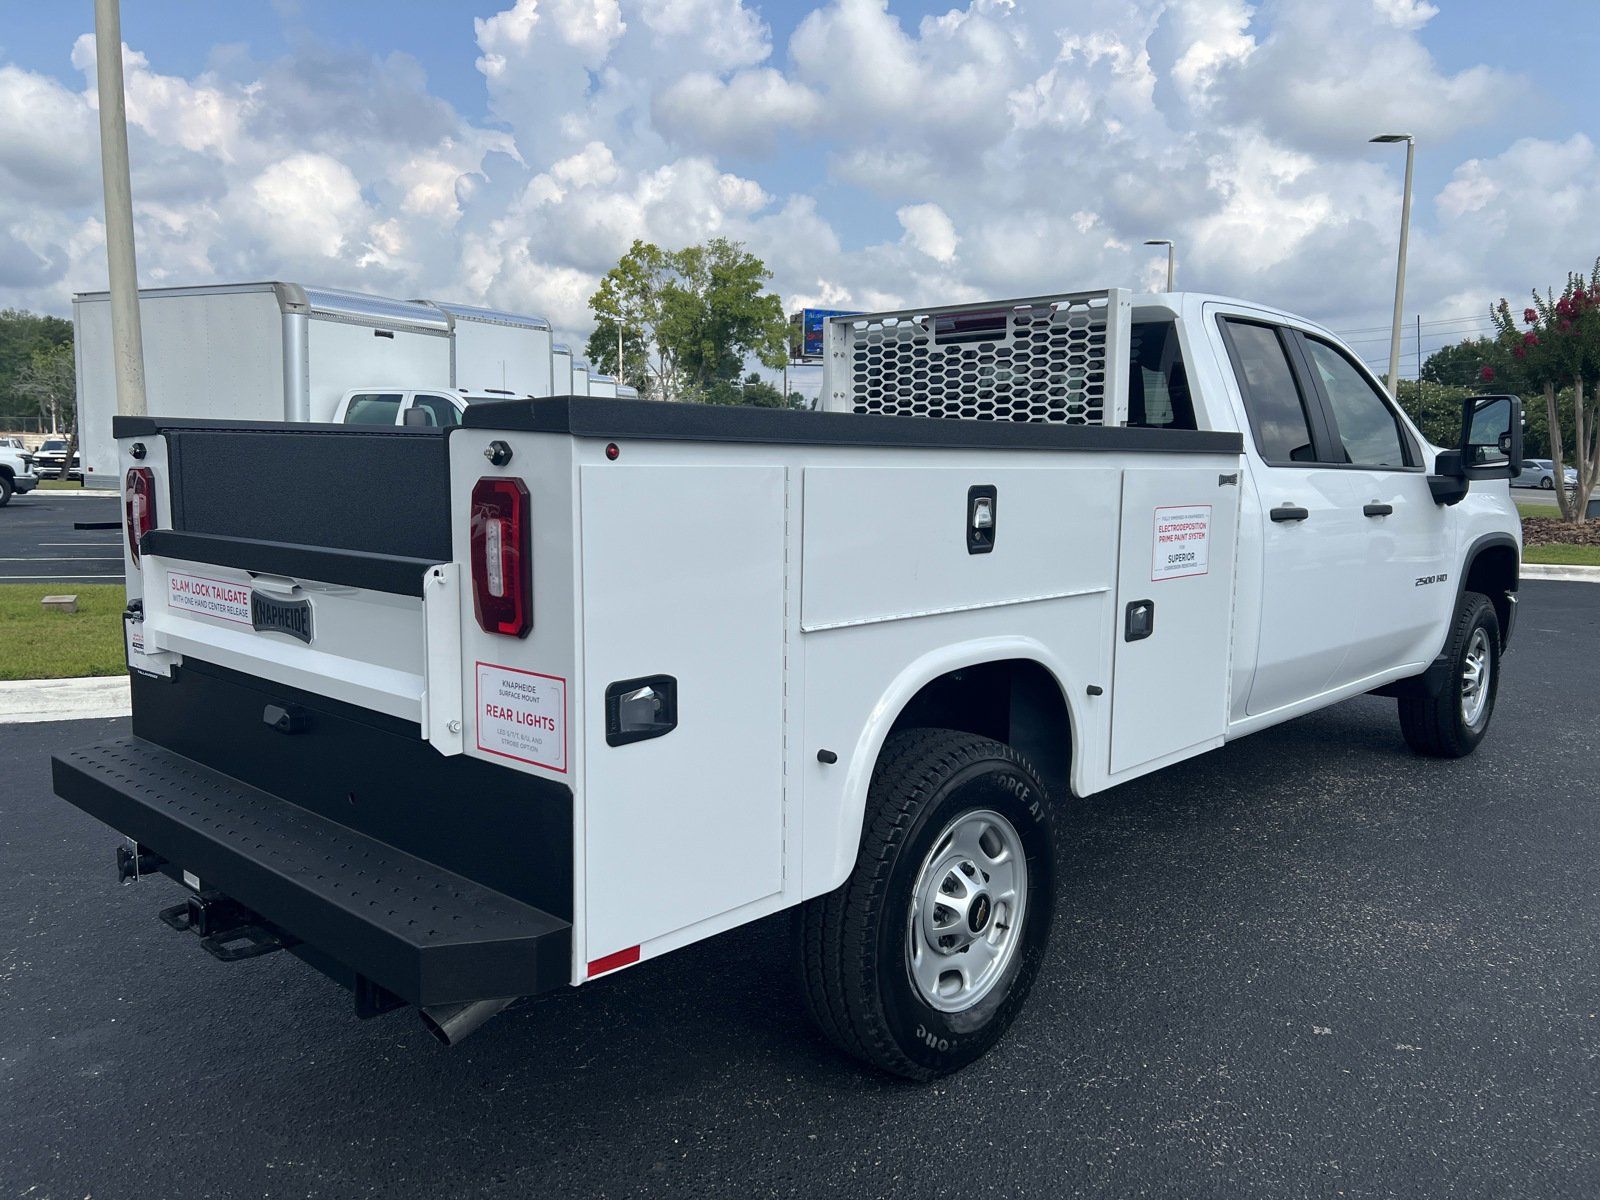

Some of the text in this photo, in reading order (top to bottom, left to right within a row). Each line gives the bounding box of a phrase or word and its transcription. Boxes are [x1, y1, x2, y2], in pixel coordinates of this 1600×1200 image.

[1158, 522, 1207, 533] ELECTRODEPOSITION
[1158, 532, 1205, 543] PRIME PAINT SYSTEM
[1168, 552, 1195, 563] SUPERIOR
[1415, 573, 1447, 587] 2500 HD
[171, 578, 248, 606] SLAM LOCK TAILGATE
[173, 593, 249, 618] WITH ONE HAND CENTER RELEASE
[253, 597, 308, 636] KNAPHEIDE
[502, 680, 537, 694] KNAPHEIDE
[499, 689, 540, 703] SURFACE MOUNT
[486, 703, 555, 732] REAR LIGHTS
[501, 738, 539, 753] STROBE OPTION
[532, 736, 543, 745] AND
